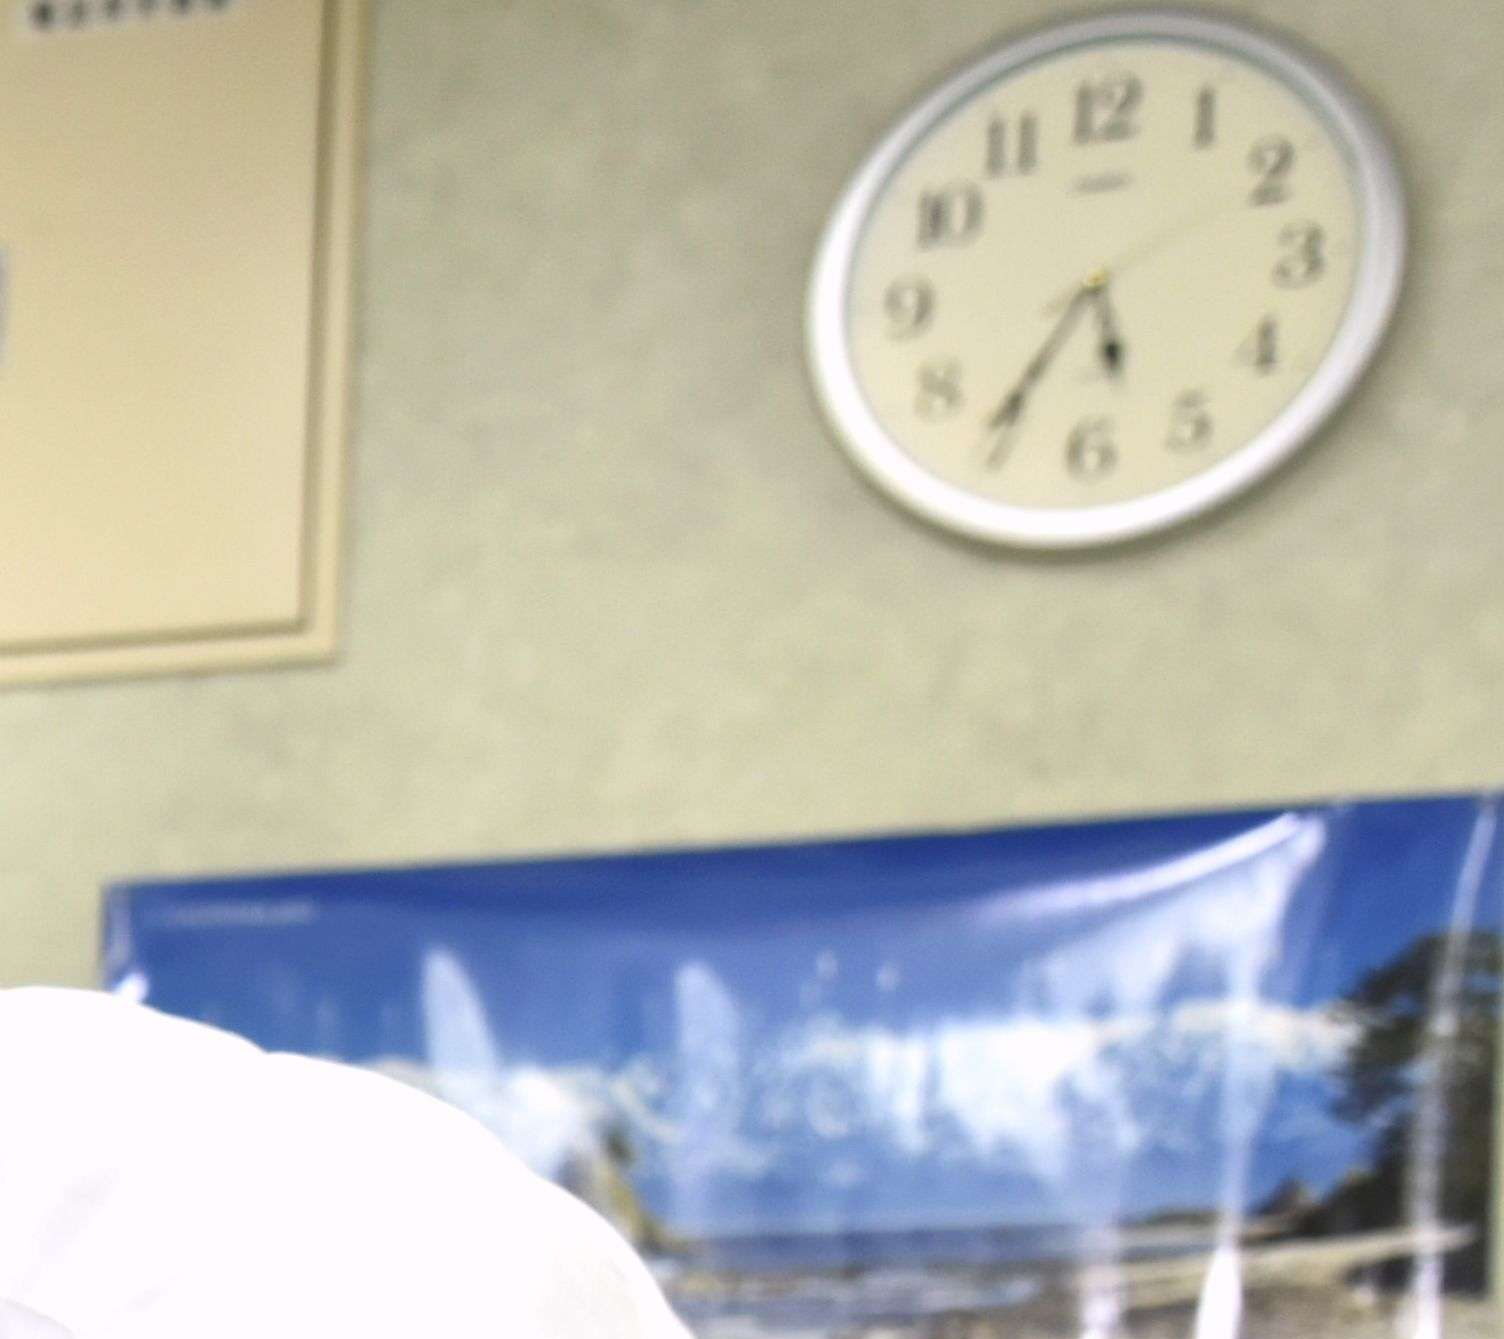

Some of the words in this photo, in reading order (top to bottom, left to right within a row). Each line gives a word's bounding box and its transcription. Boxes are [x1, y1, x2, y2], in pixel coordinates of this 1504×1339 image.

[1072, 70, 1143, 146] 12
[1192, 85, 1217, 150] 1
[985, 109, 1039, 178] 11
[1248, 135, 1296, 207] 2
[917, 179, 984, 250] 10
[1271, 219, 1326, 290] 3
[884, 275, 936, 341] 9
[1237, 315, 1279, 377] 4
[915, 355, 963, 420] 8
[1065, 415, 1118, 481] 6
[1166, 390, 1213, 452] 5
